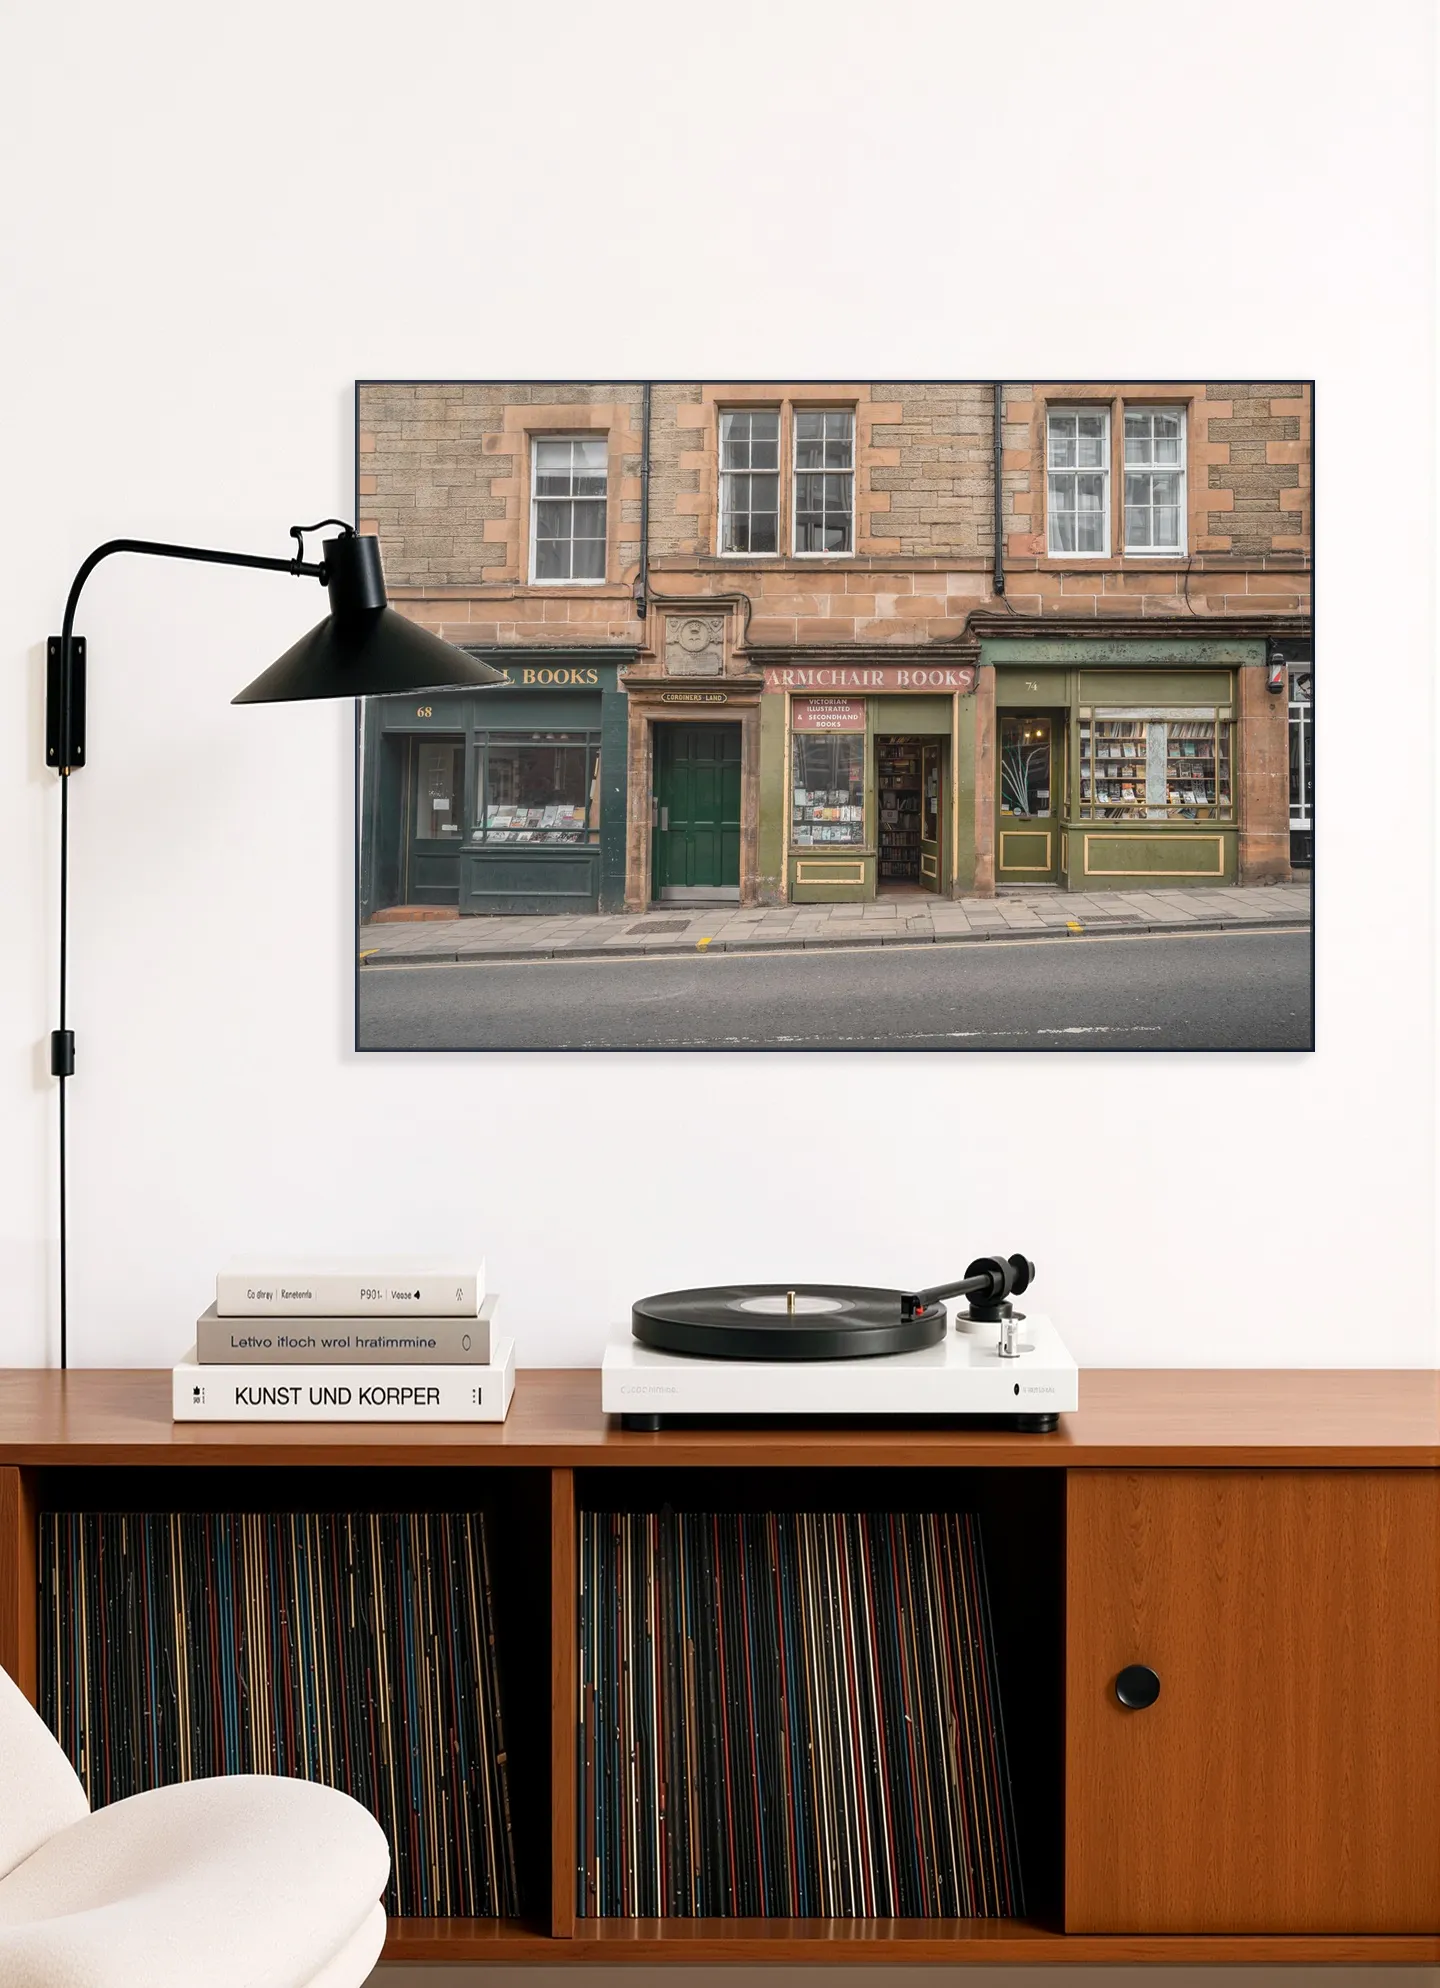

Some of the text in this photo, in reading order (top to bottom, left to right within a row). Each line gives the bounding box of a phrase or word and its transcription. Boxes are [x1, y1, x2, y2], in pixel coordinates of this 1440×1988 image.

[523, 668, 599, 685] BOOKS
[766, 670, 972, 686] ARMCHAIR BOOKS
[1025, 681, 1039, 691] 74
[417, 707, 432, 718] 68
[235, 1387, 440, 1406] KUNST UND KORPER
